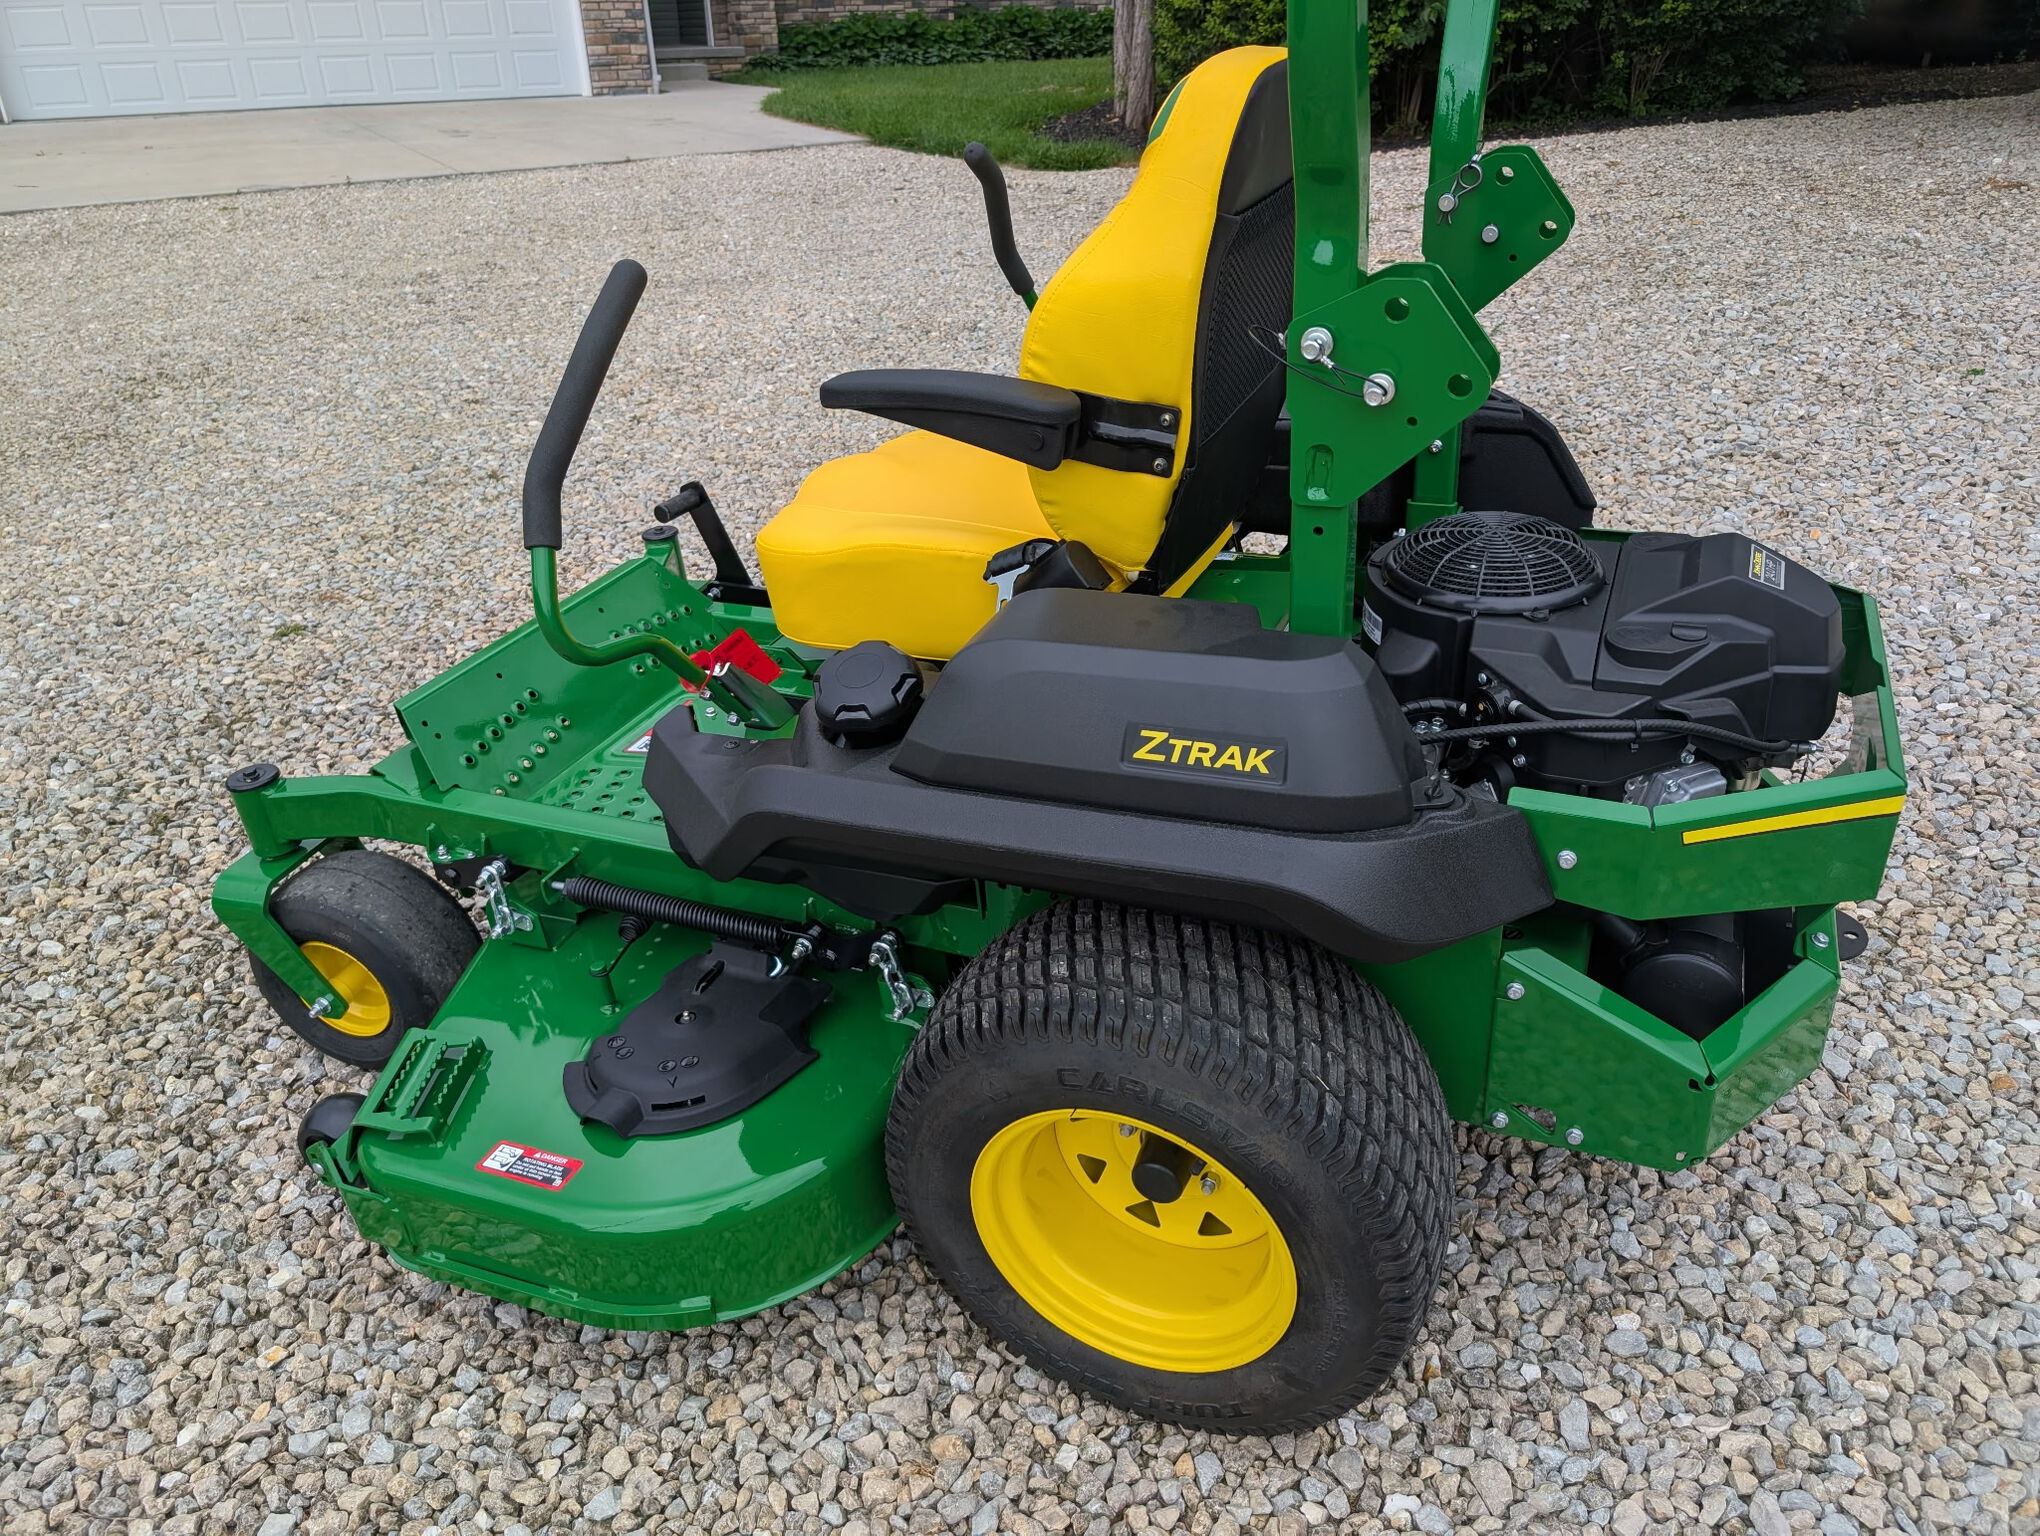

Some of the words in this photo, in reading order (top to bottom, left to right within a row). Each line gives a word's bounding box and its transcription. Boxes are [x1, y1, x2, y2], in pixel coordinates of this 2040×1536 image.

[1132, 729, 1276, 774] ZTRAK
[1057, 1067, 1293, 1188] CARLSTAR
[541, 1152, 568, 1164] DANGER
